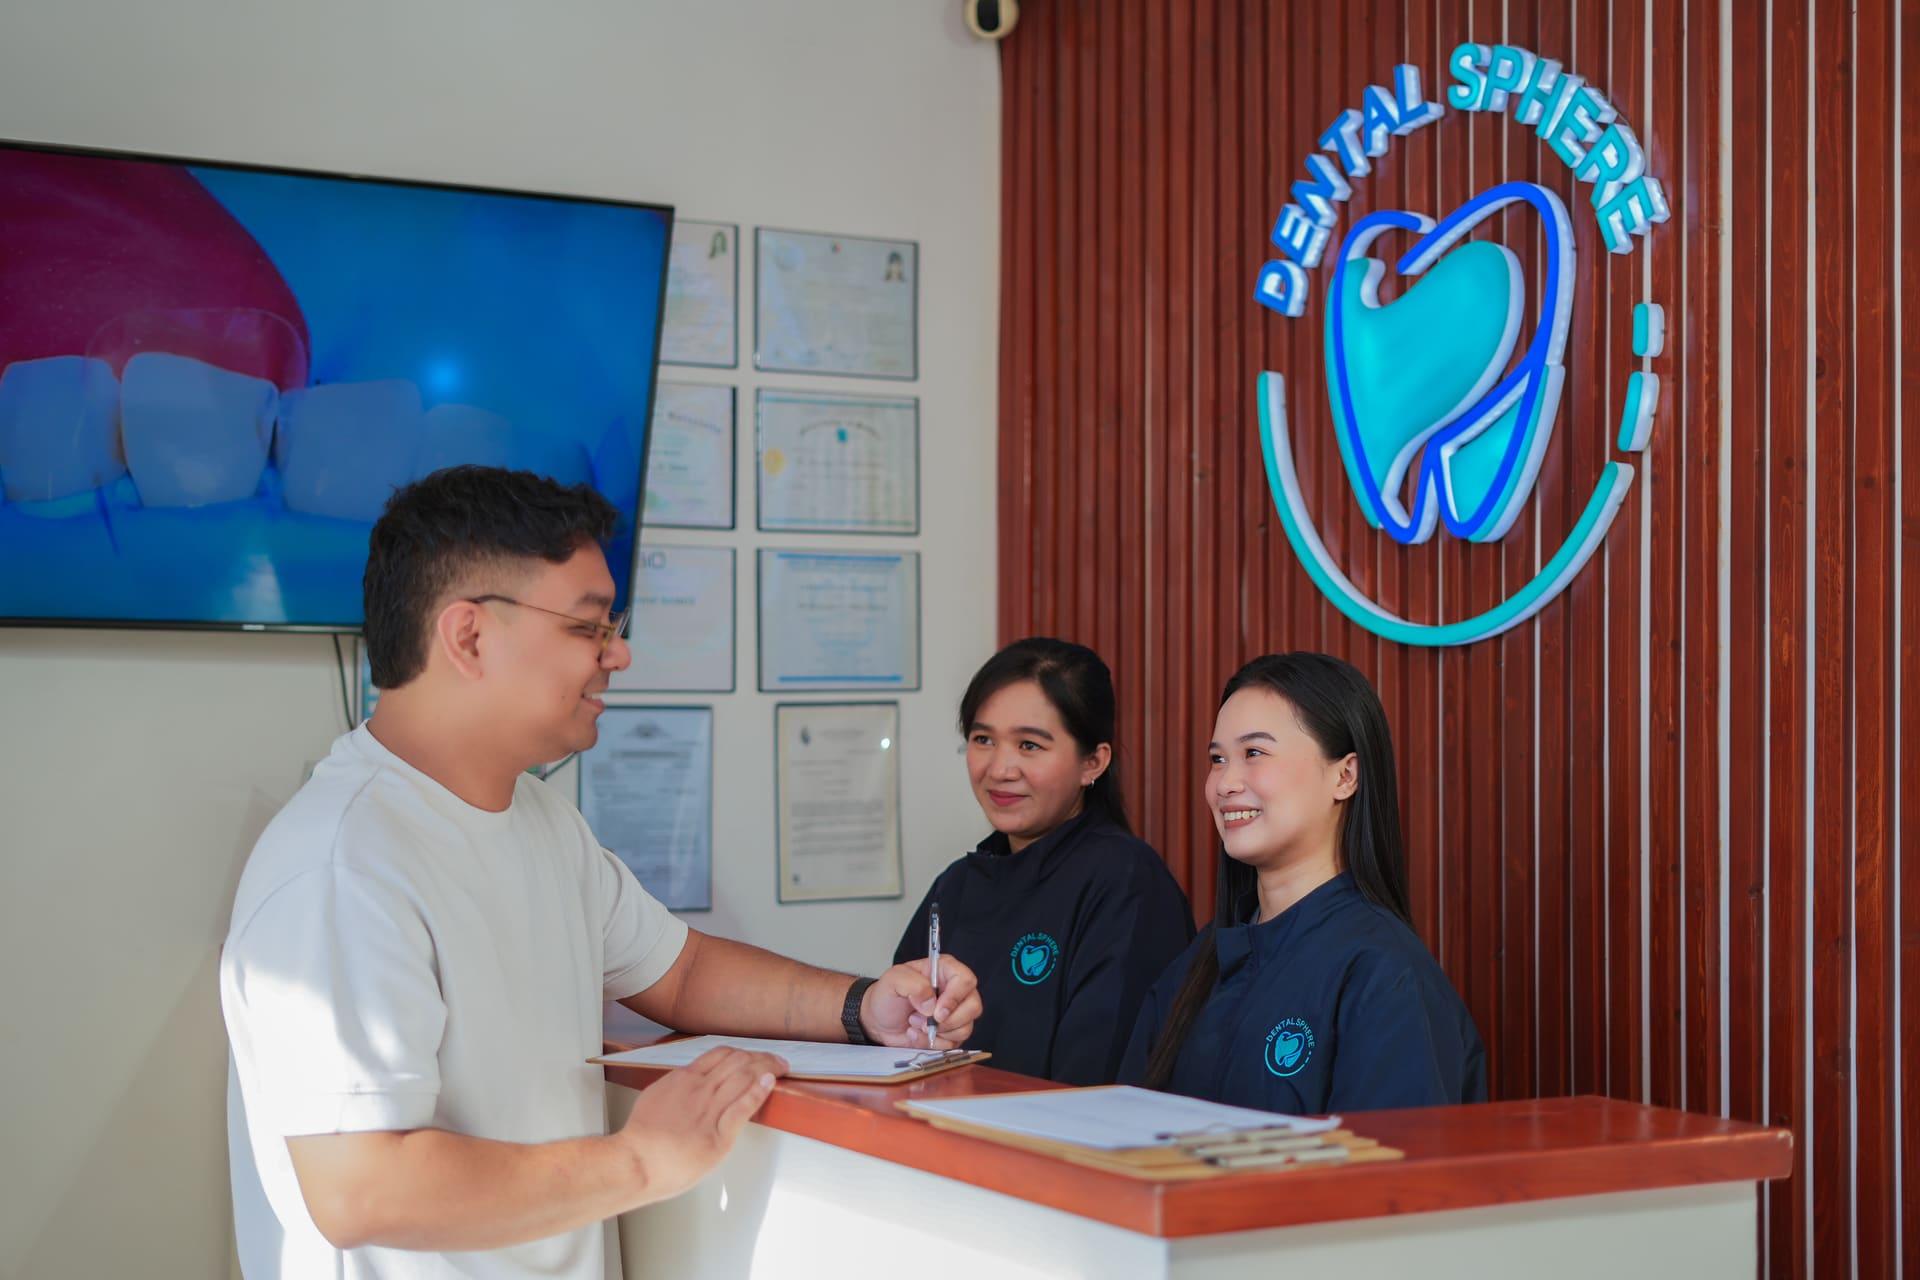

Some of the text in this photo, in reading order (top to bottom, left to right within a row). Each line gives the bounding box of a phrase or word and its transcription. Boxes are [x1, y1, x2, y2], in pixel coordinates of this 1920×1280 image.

[1254, 42, 1671, 317] DENTAL SPHERE
[1010, 932, 1035, 957] DENTAL
[1266, 1017, 1315, 1048] DENTAL SPHERE
